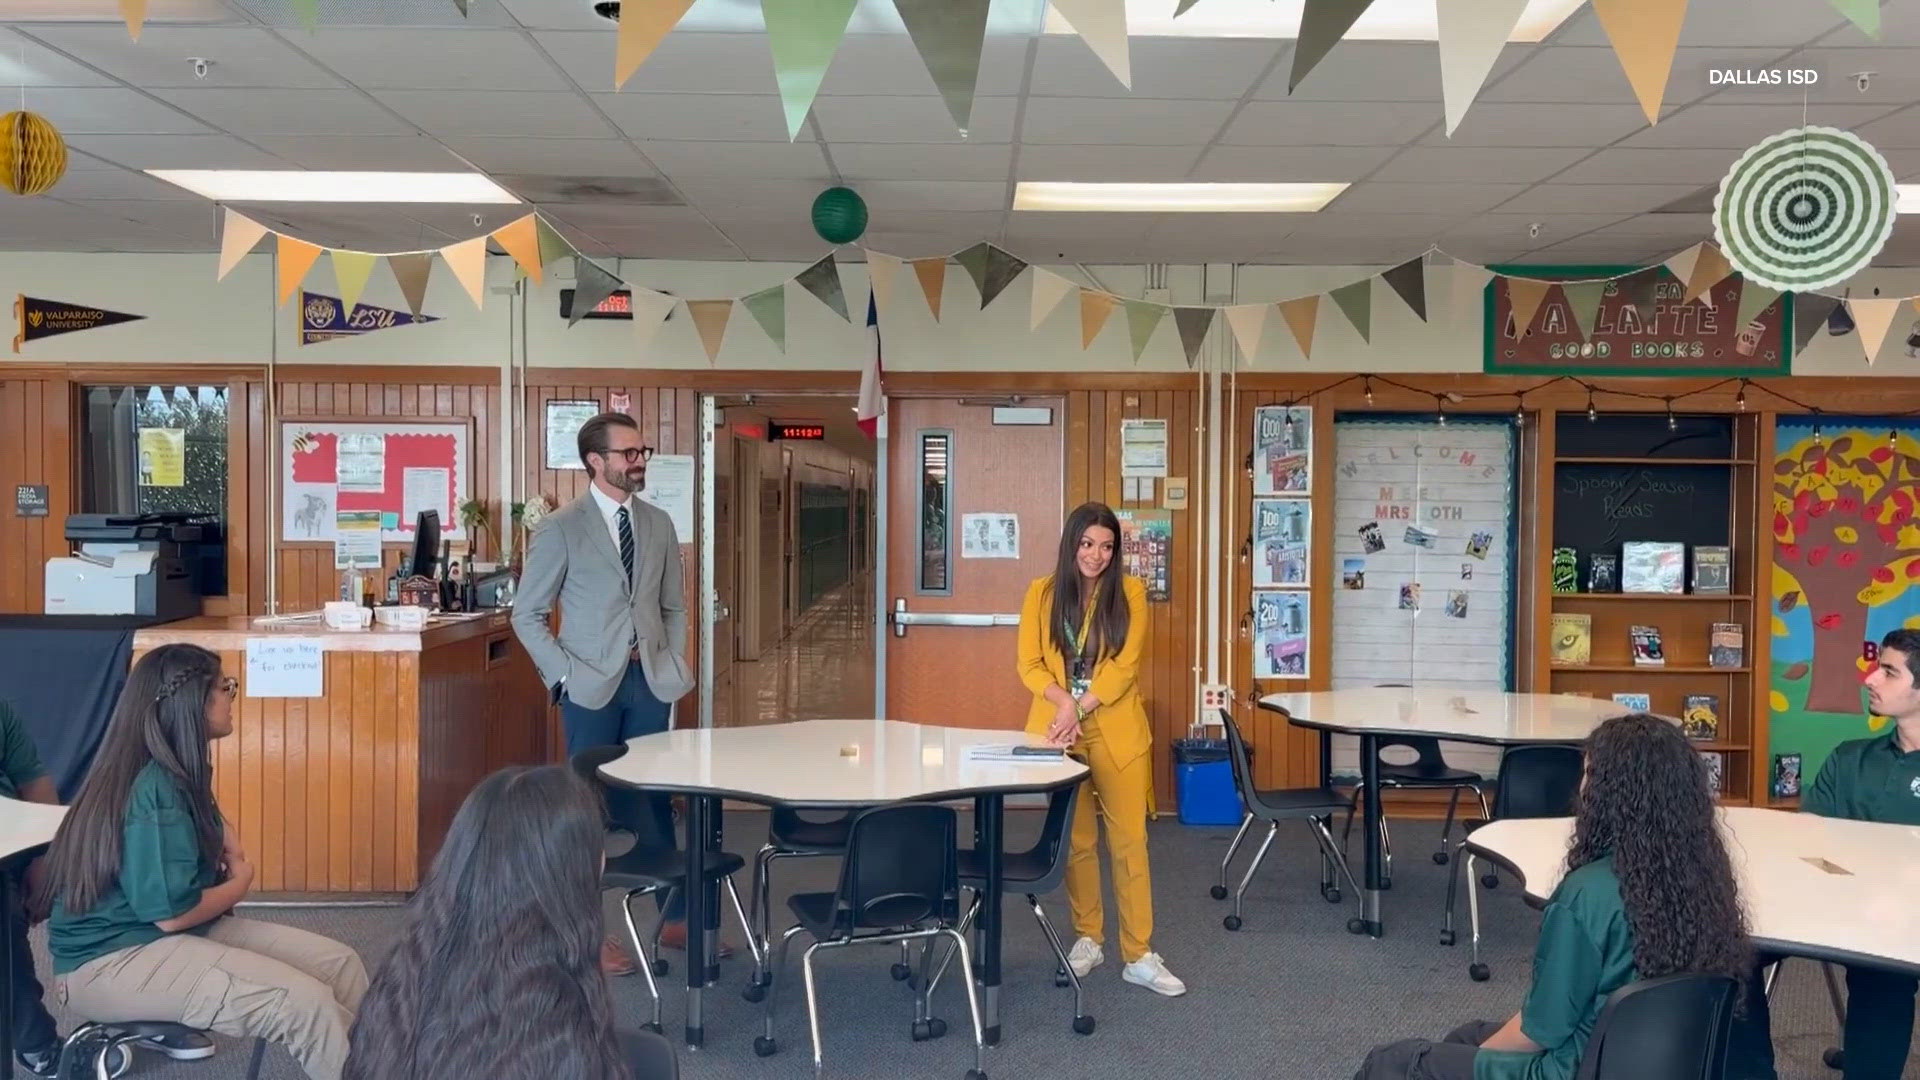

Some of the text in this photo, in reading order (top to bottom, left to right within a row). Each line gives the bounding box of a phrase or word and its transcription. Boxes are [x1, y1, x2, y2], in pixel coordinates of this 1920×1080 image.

[46, 311, 104, 320] VALPARAISO
[46, 320, 95, 329] UNIVERSITY
[350, 308, 397, 329] LSU
[1550, 341, 1705, 359] GOOD BOOKS
[1340, 444, 1496, 478] WELCOME
[1639, 470, 1695, 494] Season
[1375, 505, 1410, 520] MRS
[1260, 602, 1279, 621] 200
